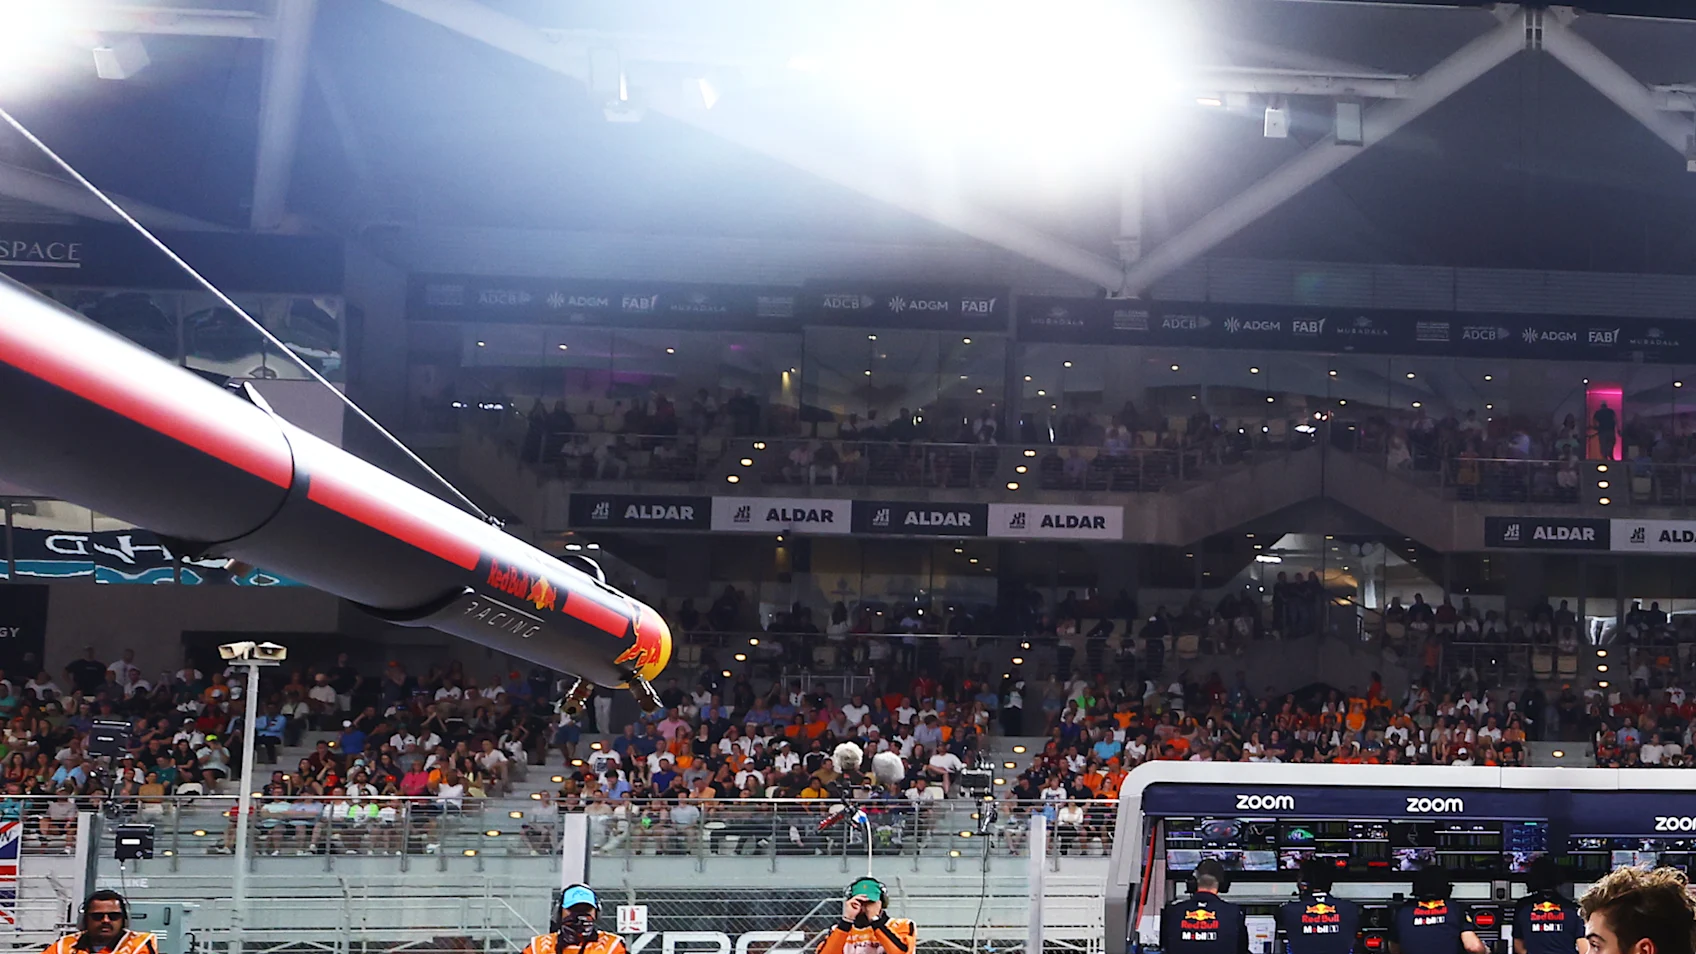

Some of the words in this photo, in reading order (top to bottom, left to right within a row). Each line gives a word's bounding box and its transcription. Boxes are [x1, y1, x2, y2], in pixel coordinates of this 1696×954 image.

[909, 300, 949, 312] ADGM
[960, 300, 989, 313] FAB
[1161, 317, 1198, 330] ADCB
[1242, 319, 1281, 331] ADGM
[1292, 320, 1318, 334] FAB
[1462, 328, 1497, 341] ADCB
[1540, 330, 1577, 342] ADGM
[1588, 330, 1614, 343] FAB
[624, 504, 695, 522] ALDAR
[765, 506, 834, 524] ALDAR
[904, 509, 972, 528] ALDAR
[1039, 512, 1107, 531] ALDAR
[1532, 525, 1596, 542] ALDAR
[487, 558, 510, 594] Red
[507, 565, 529, 599] Bull
[1235, 794, 1295, 811] zoom
[1405, 797, 1465, 813] zoom
[1414, 907, 1429, 916] Red
[1429, 906, 1448, 915] Bull
[1530, 912, 1547, 921] Red
[1548, 912, 1565, 921] Bull
[1181, 920, 1201, 930] Red
[1201, 919, 1219, 929] Bull
[1302, 914, 1321, 924] Red
[1321, 913, 1340, 923] Bull
